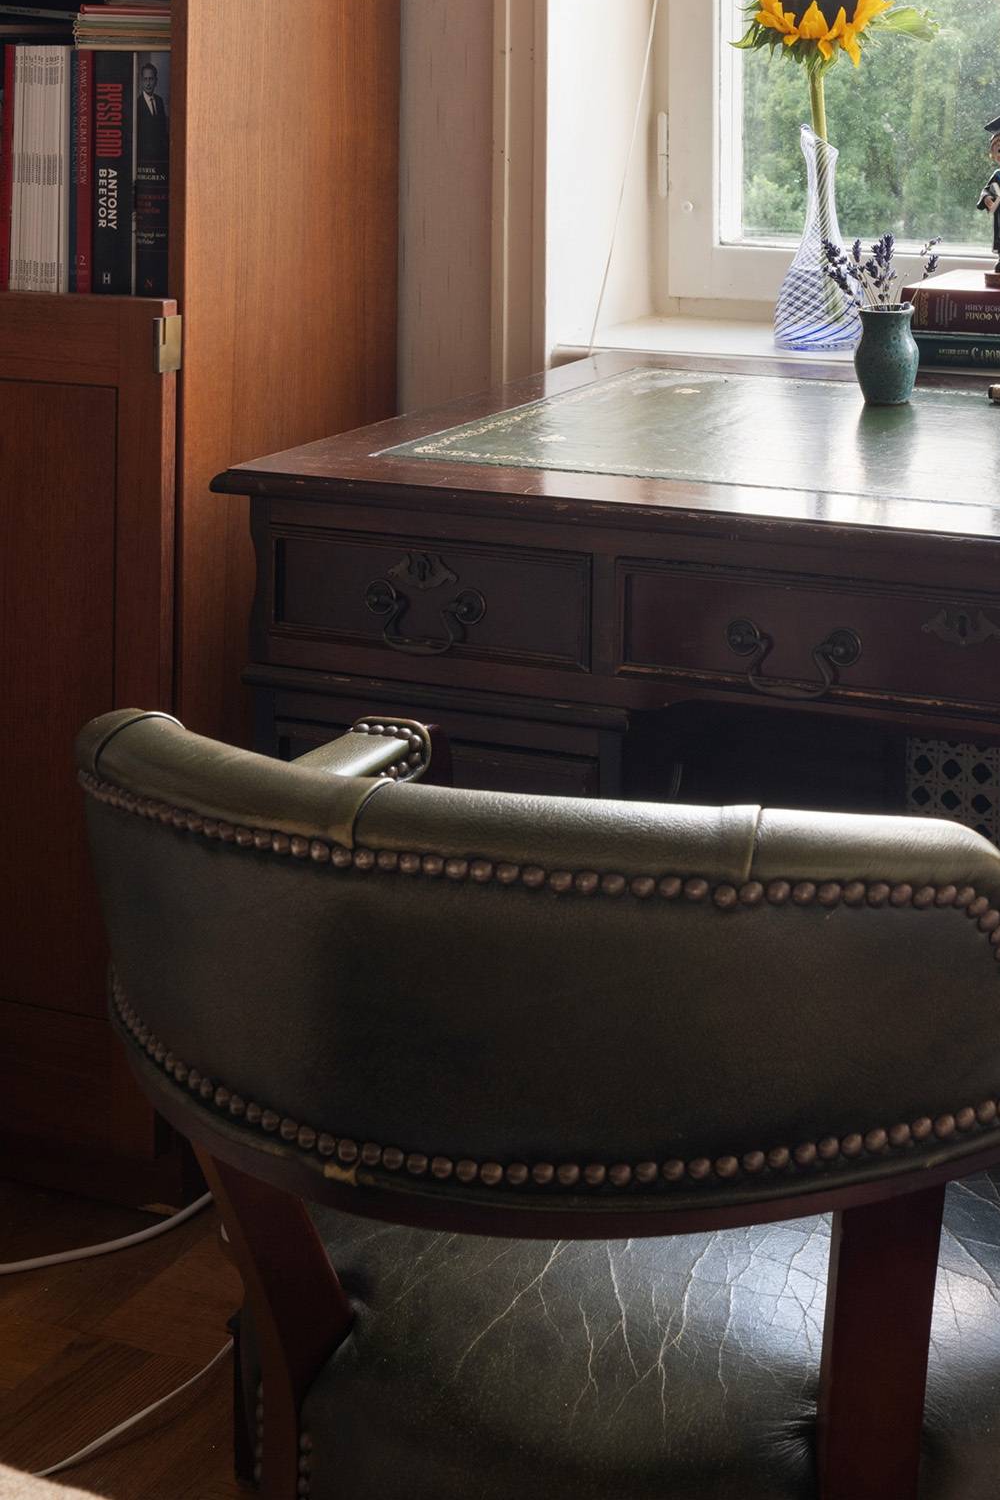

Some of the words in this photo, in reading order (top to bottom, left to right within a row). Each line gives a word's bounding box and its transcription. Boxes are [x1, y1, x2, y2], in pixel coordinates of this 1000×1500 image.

[79, 59, 88, 113] MAWLANA
[79, 115, 88, 143] RUMI
[95, 83, 123, 159] RYSSLAND
[79, 146, 87, 185] REVIEW
[97, 168, 107, 228] BEEVOR
[107, 168, 118, 230] ANTONY
